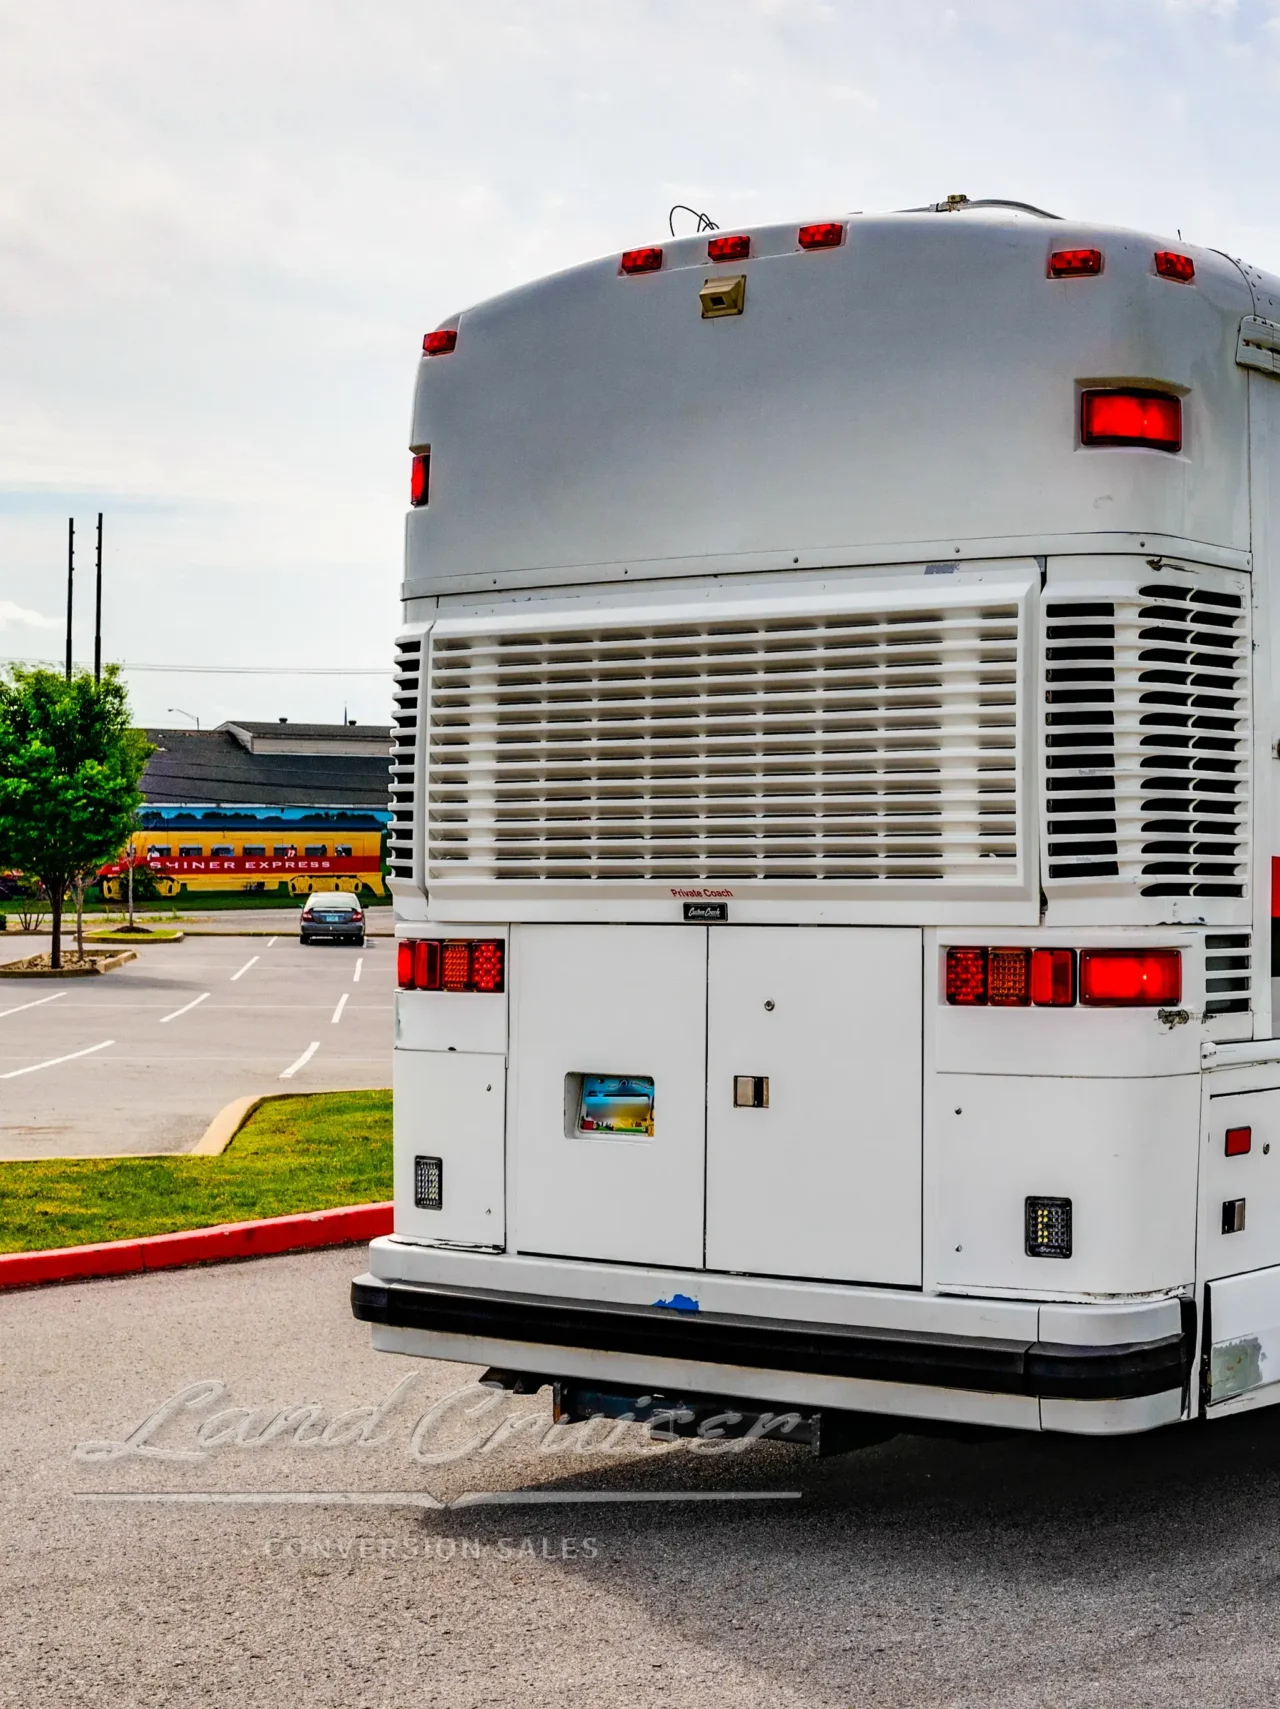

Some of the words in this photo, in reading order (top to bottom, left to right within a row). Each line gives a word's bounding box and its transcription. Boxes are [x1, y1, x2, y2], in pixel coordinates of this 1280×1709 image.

[245, 861, 331, 869] EXPRESS
[670, 888, 703, 897] Private
[703, 888, 734, 897] Coach
